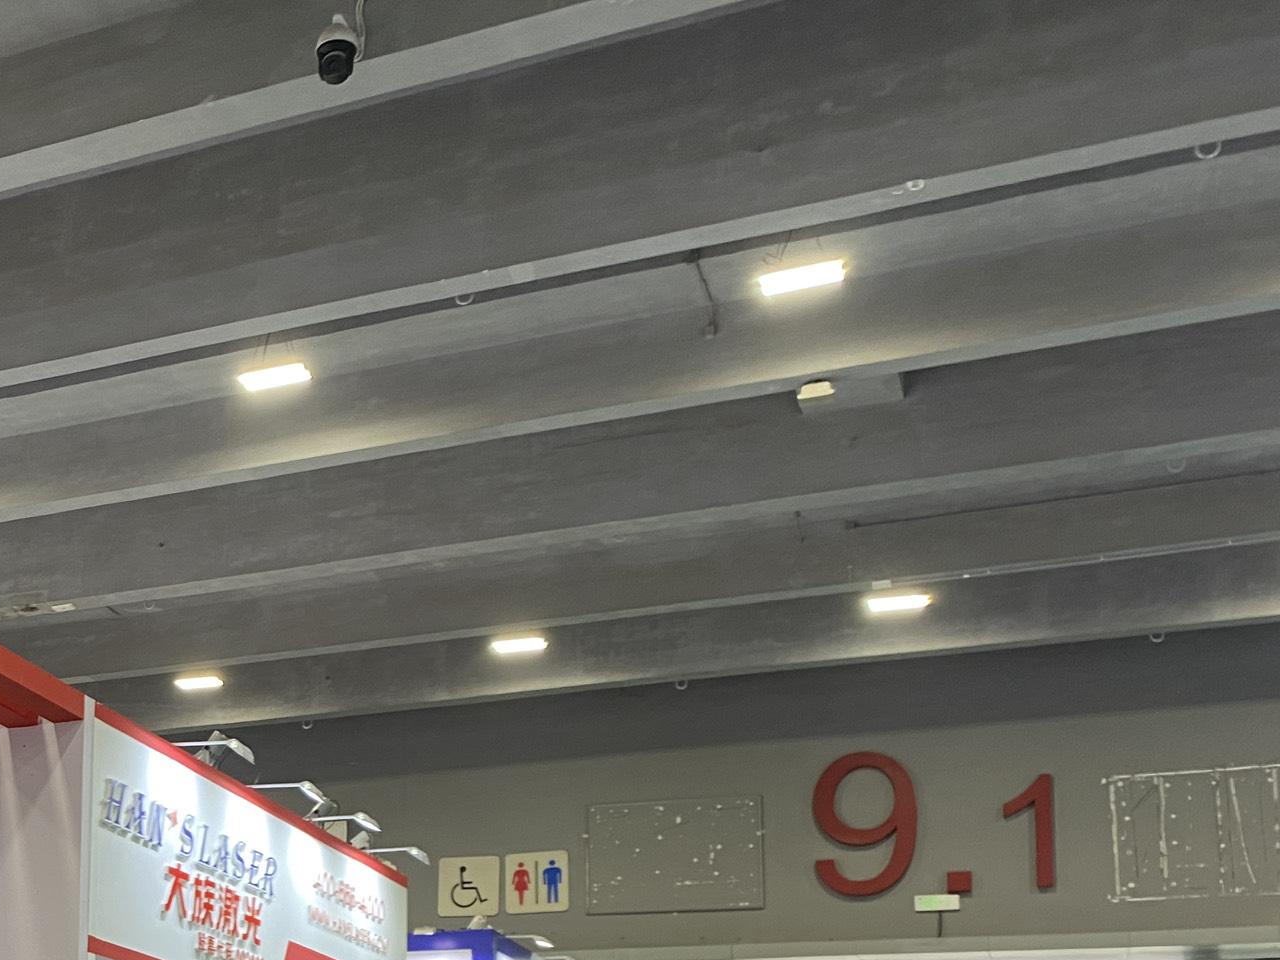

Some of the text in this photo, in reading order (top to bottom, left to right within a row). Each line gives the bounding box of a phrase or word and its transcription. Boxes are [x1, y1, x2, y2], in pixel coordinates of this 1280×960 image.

[811, 751, 1055, 897] 9.1
[163, 862, 262, 947] 大族激光
